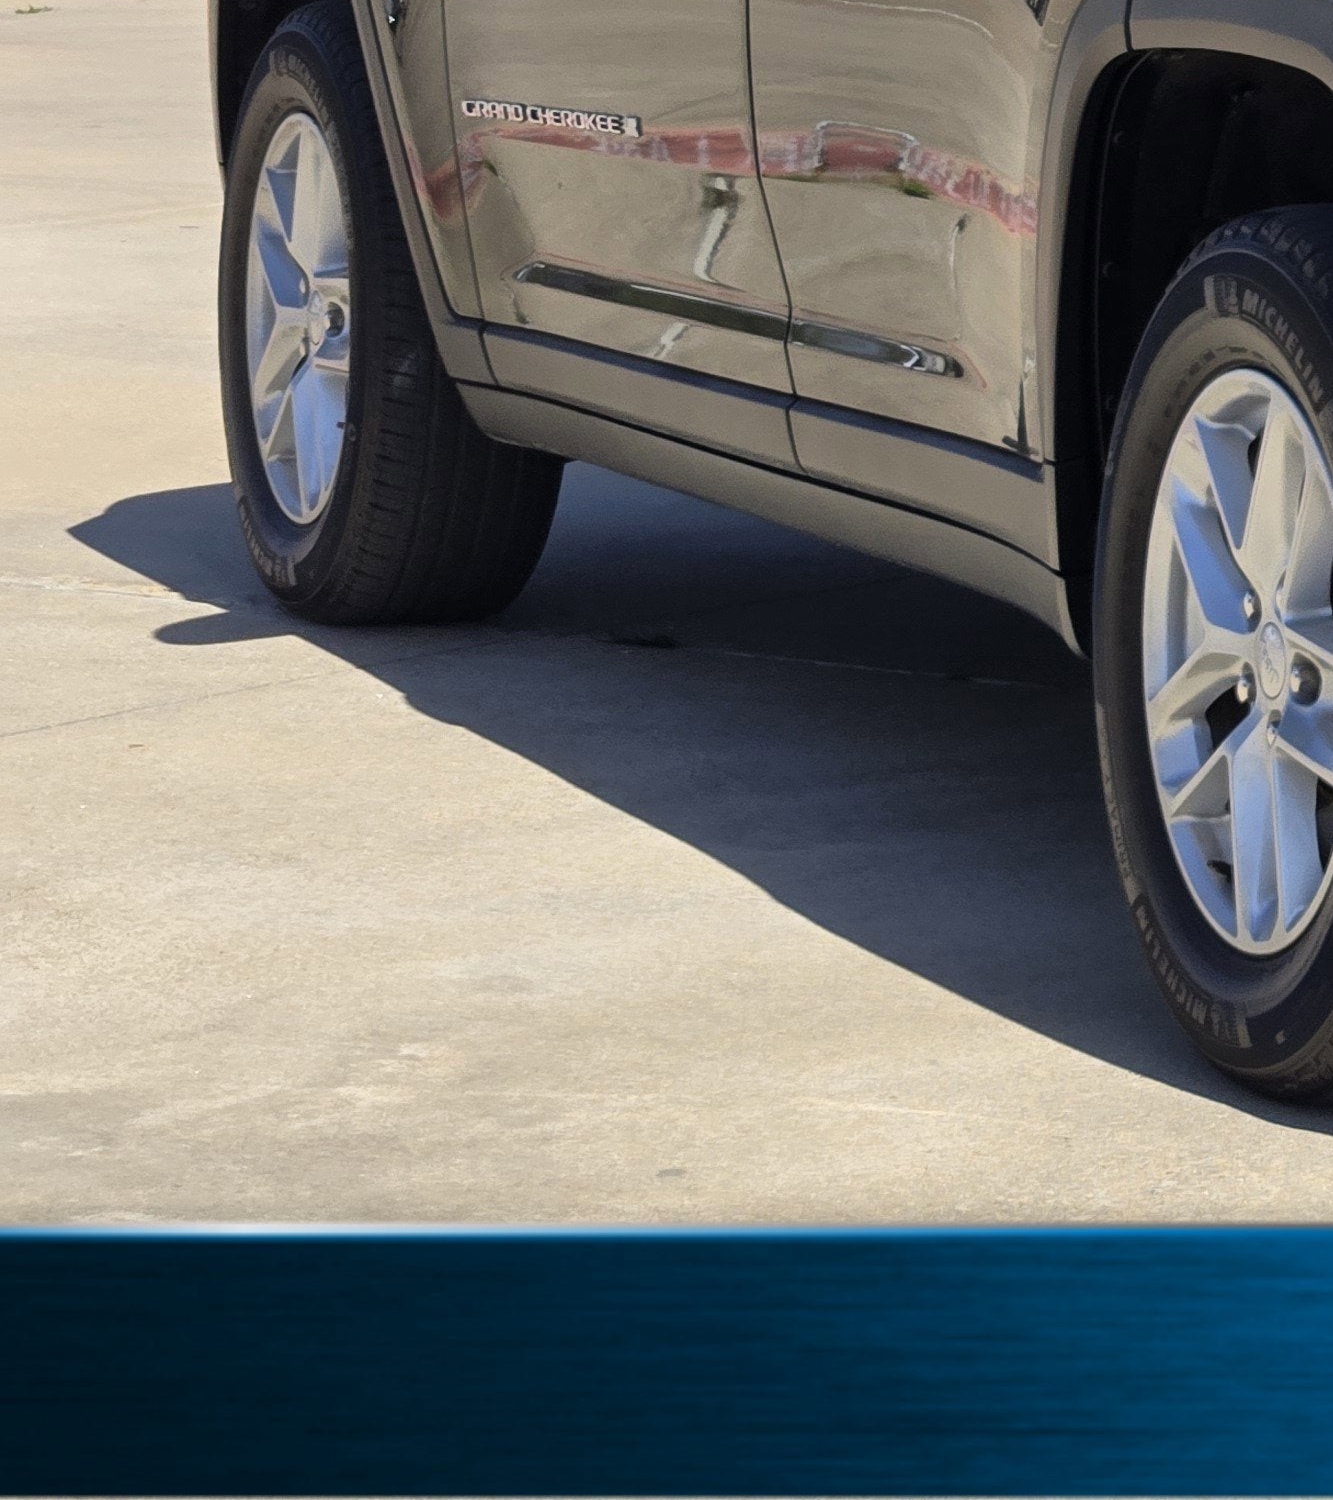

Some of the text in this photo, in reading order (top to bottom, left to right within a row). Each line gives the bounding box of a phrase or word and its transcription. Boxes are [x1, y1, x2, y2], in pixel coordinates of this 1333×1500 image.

[461, 100, 524, 122] GRAND
[526, 106, 621, 134] CHEROKEE
[1242, 288, 1324, 404] MICHELIN
